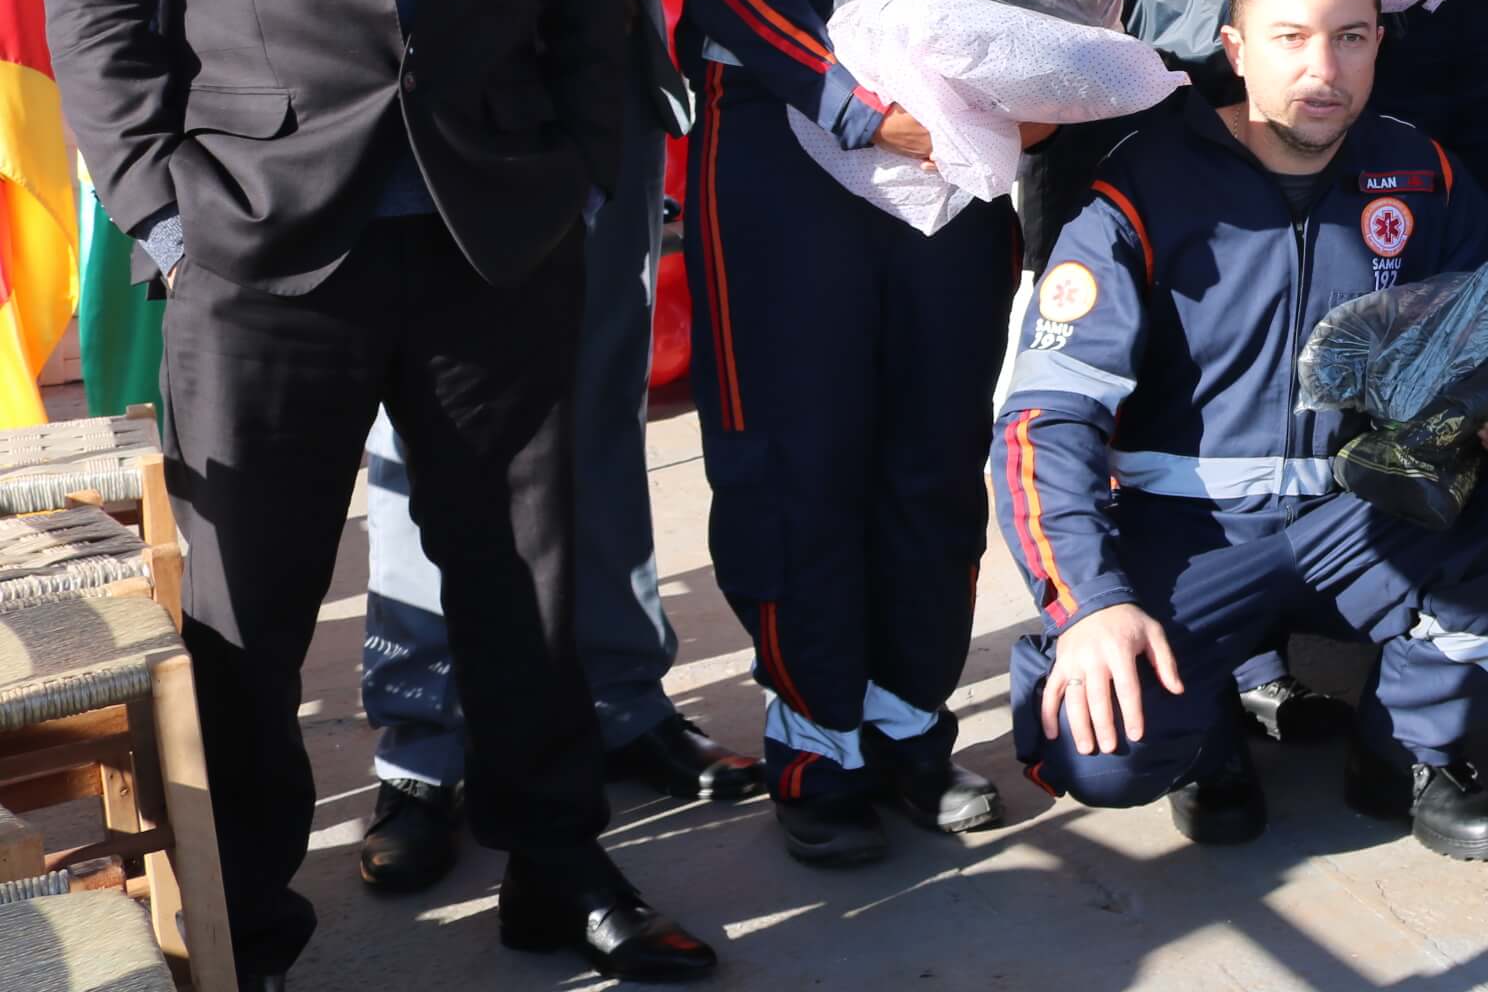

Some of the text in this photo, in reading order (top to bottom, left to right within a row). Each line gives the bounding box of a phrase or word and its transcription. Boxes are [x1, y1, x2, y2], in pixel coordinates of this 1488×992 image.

[1367, 175, 1398, 189] ALAN
[1372, 257, 1402, 271] SAMU
[1374, 270, 1398, 291] 192
[1036, 317, 1074, 337] SAMU
